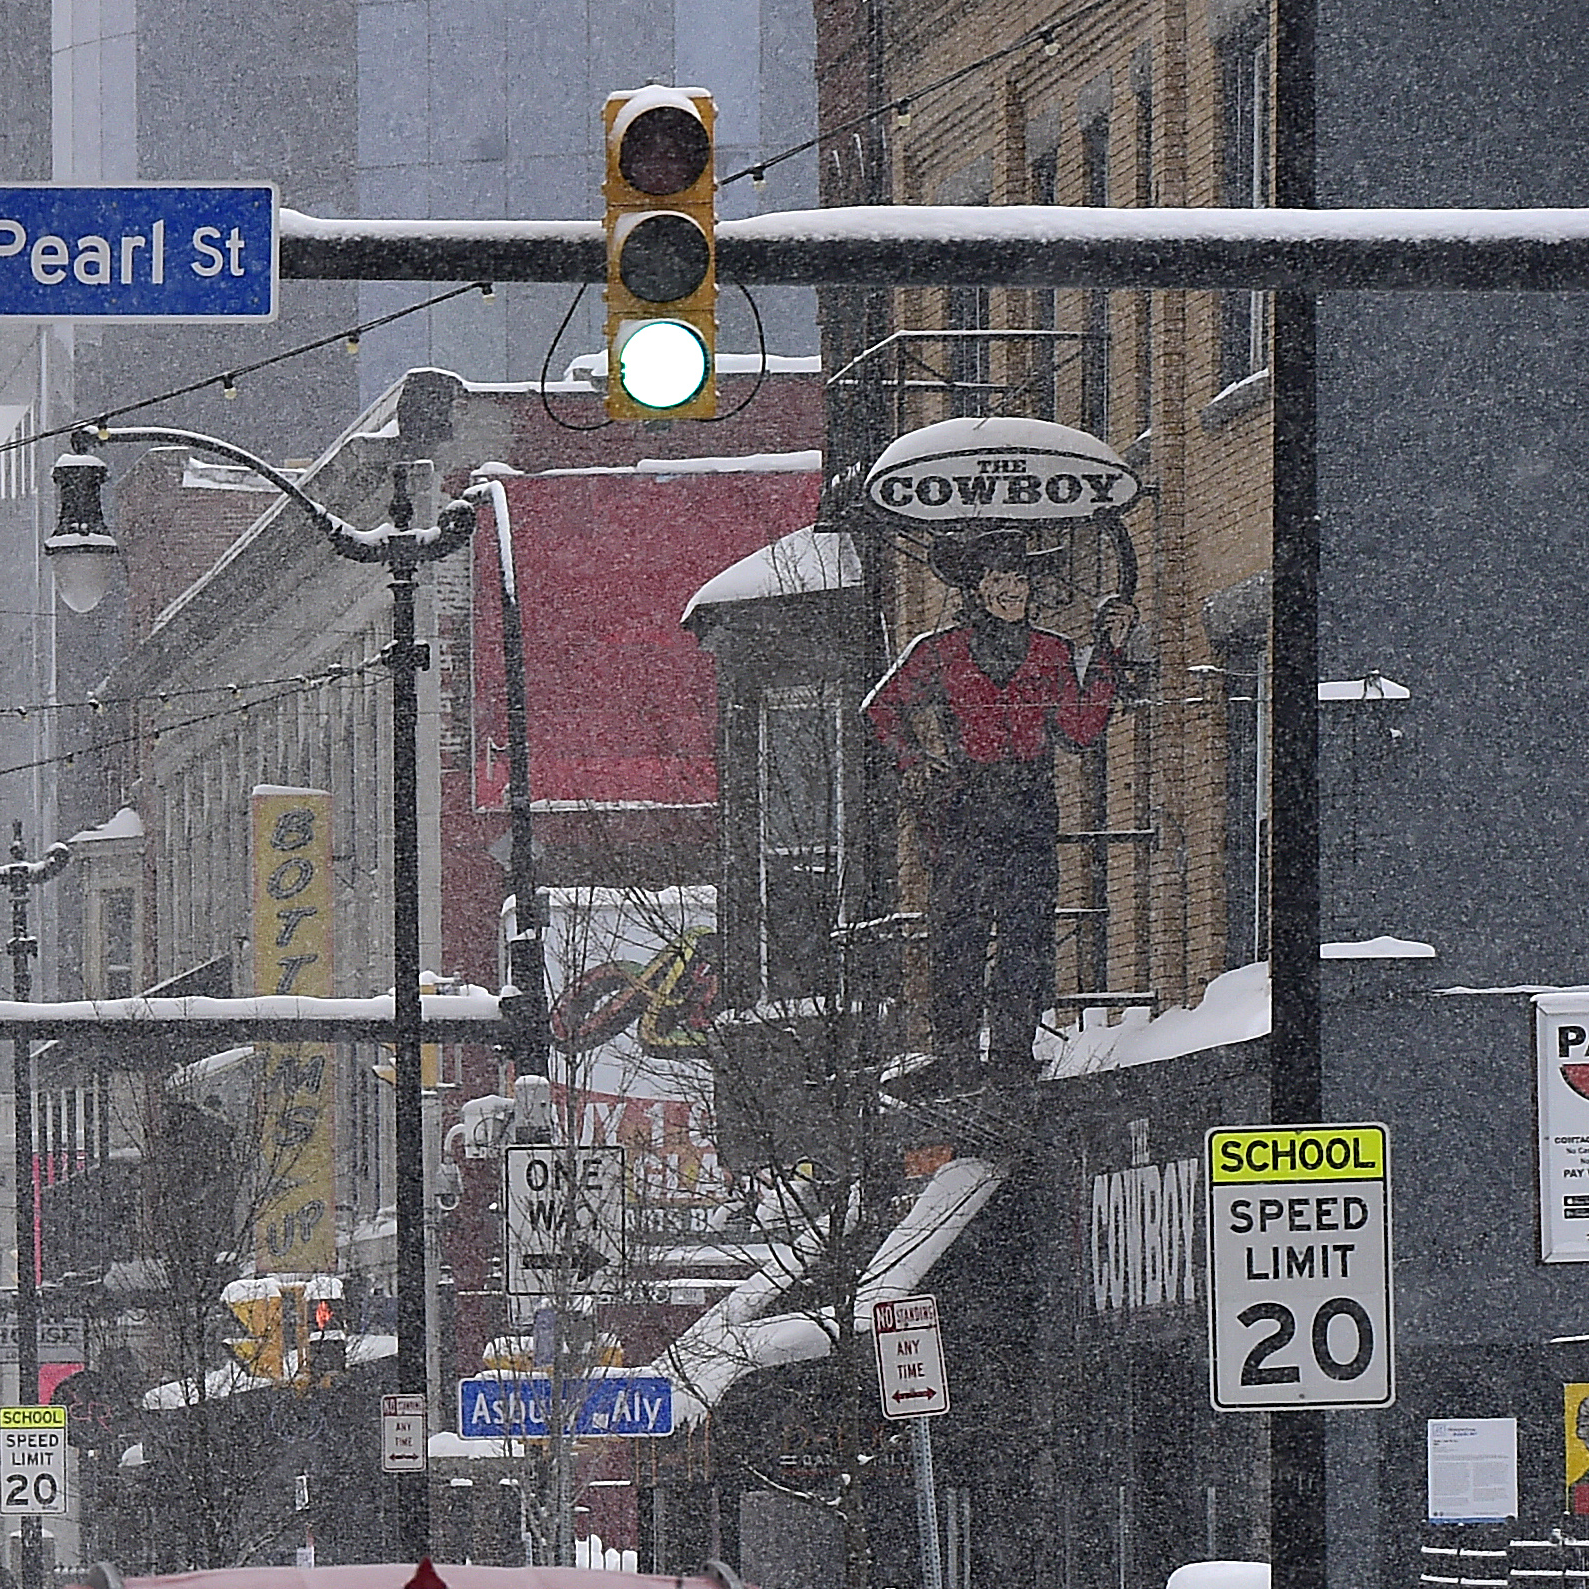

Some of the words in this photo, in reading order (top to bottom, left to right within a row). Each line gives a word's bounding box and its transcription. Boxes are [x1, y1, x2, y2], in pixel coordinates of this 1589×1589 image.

[190, 226, 245, 277] St
[977, 459, 1026, 474] THE
[879, 474, 1123, 507] COWBOY
[1220, 1137, 1375, 1172] SCHOOL
[526, 1159, 602, 1192] ONE
[1564, 1169, 1584, 1178] PAY
[267, 1200, 322, 1257] UP
[1229, 1196, 1368, 1234] SPEED
[1091, 1158, 1198, 1311] COWBOY
[1246, 1244, 1355, 1280] LIMIT
[876, 1306, 893, 1328] NO
[897, 1340, 920, 1355] ANY
[1237, 1297, 1374, 1386] 20
[897, 1363, 925, 1379] TIME
[3, 1411, 62, 1424] SCHOOL
[611, 1390, 663, 1430] Aly
[6, 1433, 59, 1448] SPEED
[12, 1452, 53, 1466] LIMIT
[6, 1473, 57, 1506] 20
